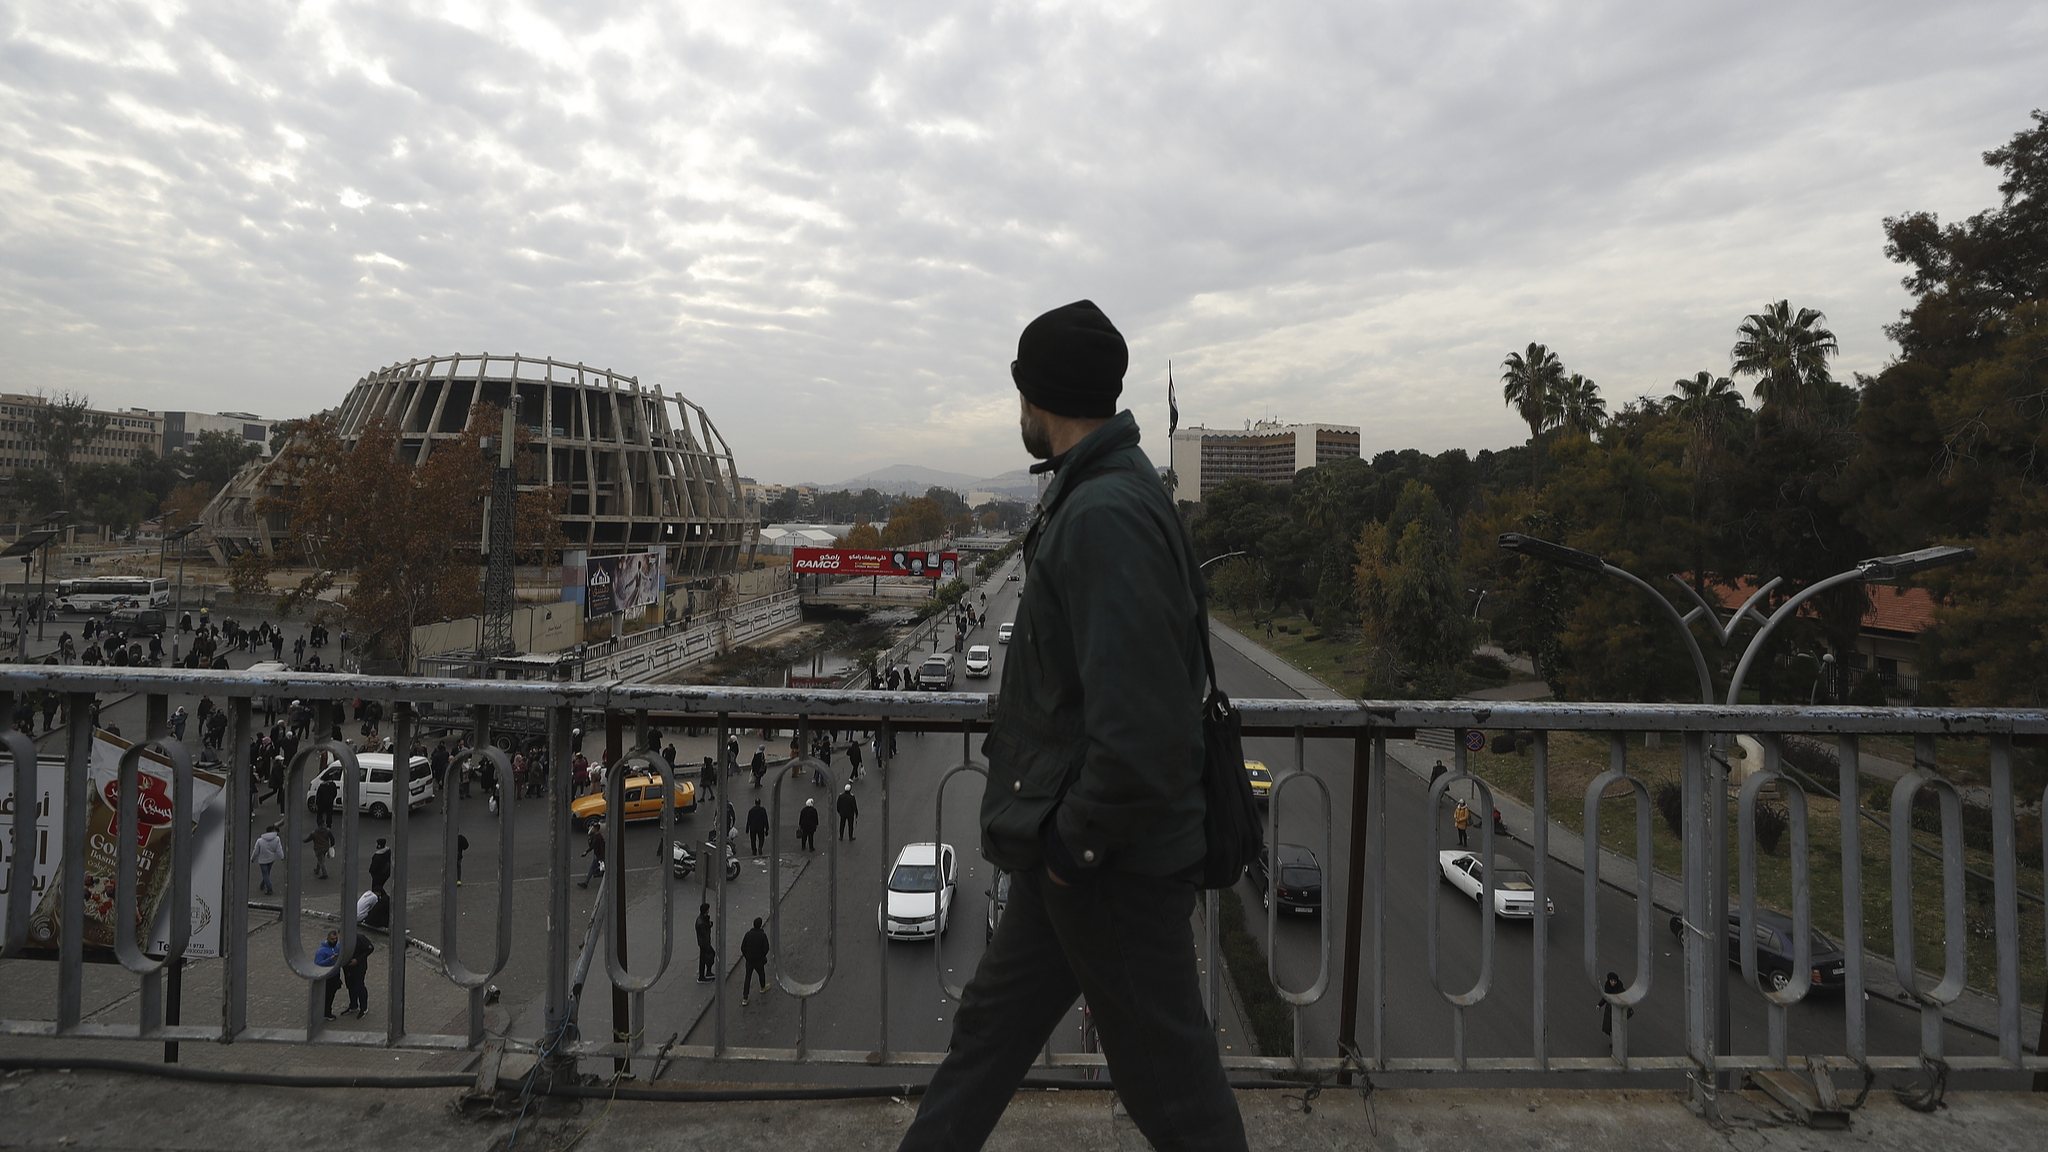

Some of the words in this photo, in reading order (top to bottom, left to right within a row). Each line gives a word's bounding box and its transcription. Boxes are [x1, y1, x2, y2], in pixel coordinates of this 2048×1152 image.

[820, 553, 840, 561] رامكو
[796, 560, 840, 569] RAMCO
[90, 833, 152, 871] Gon
